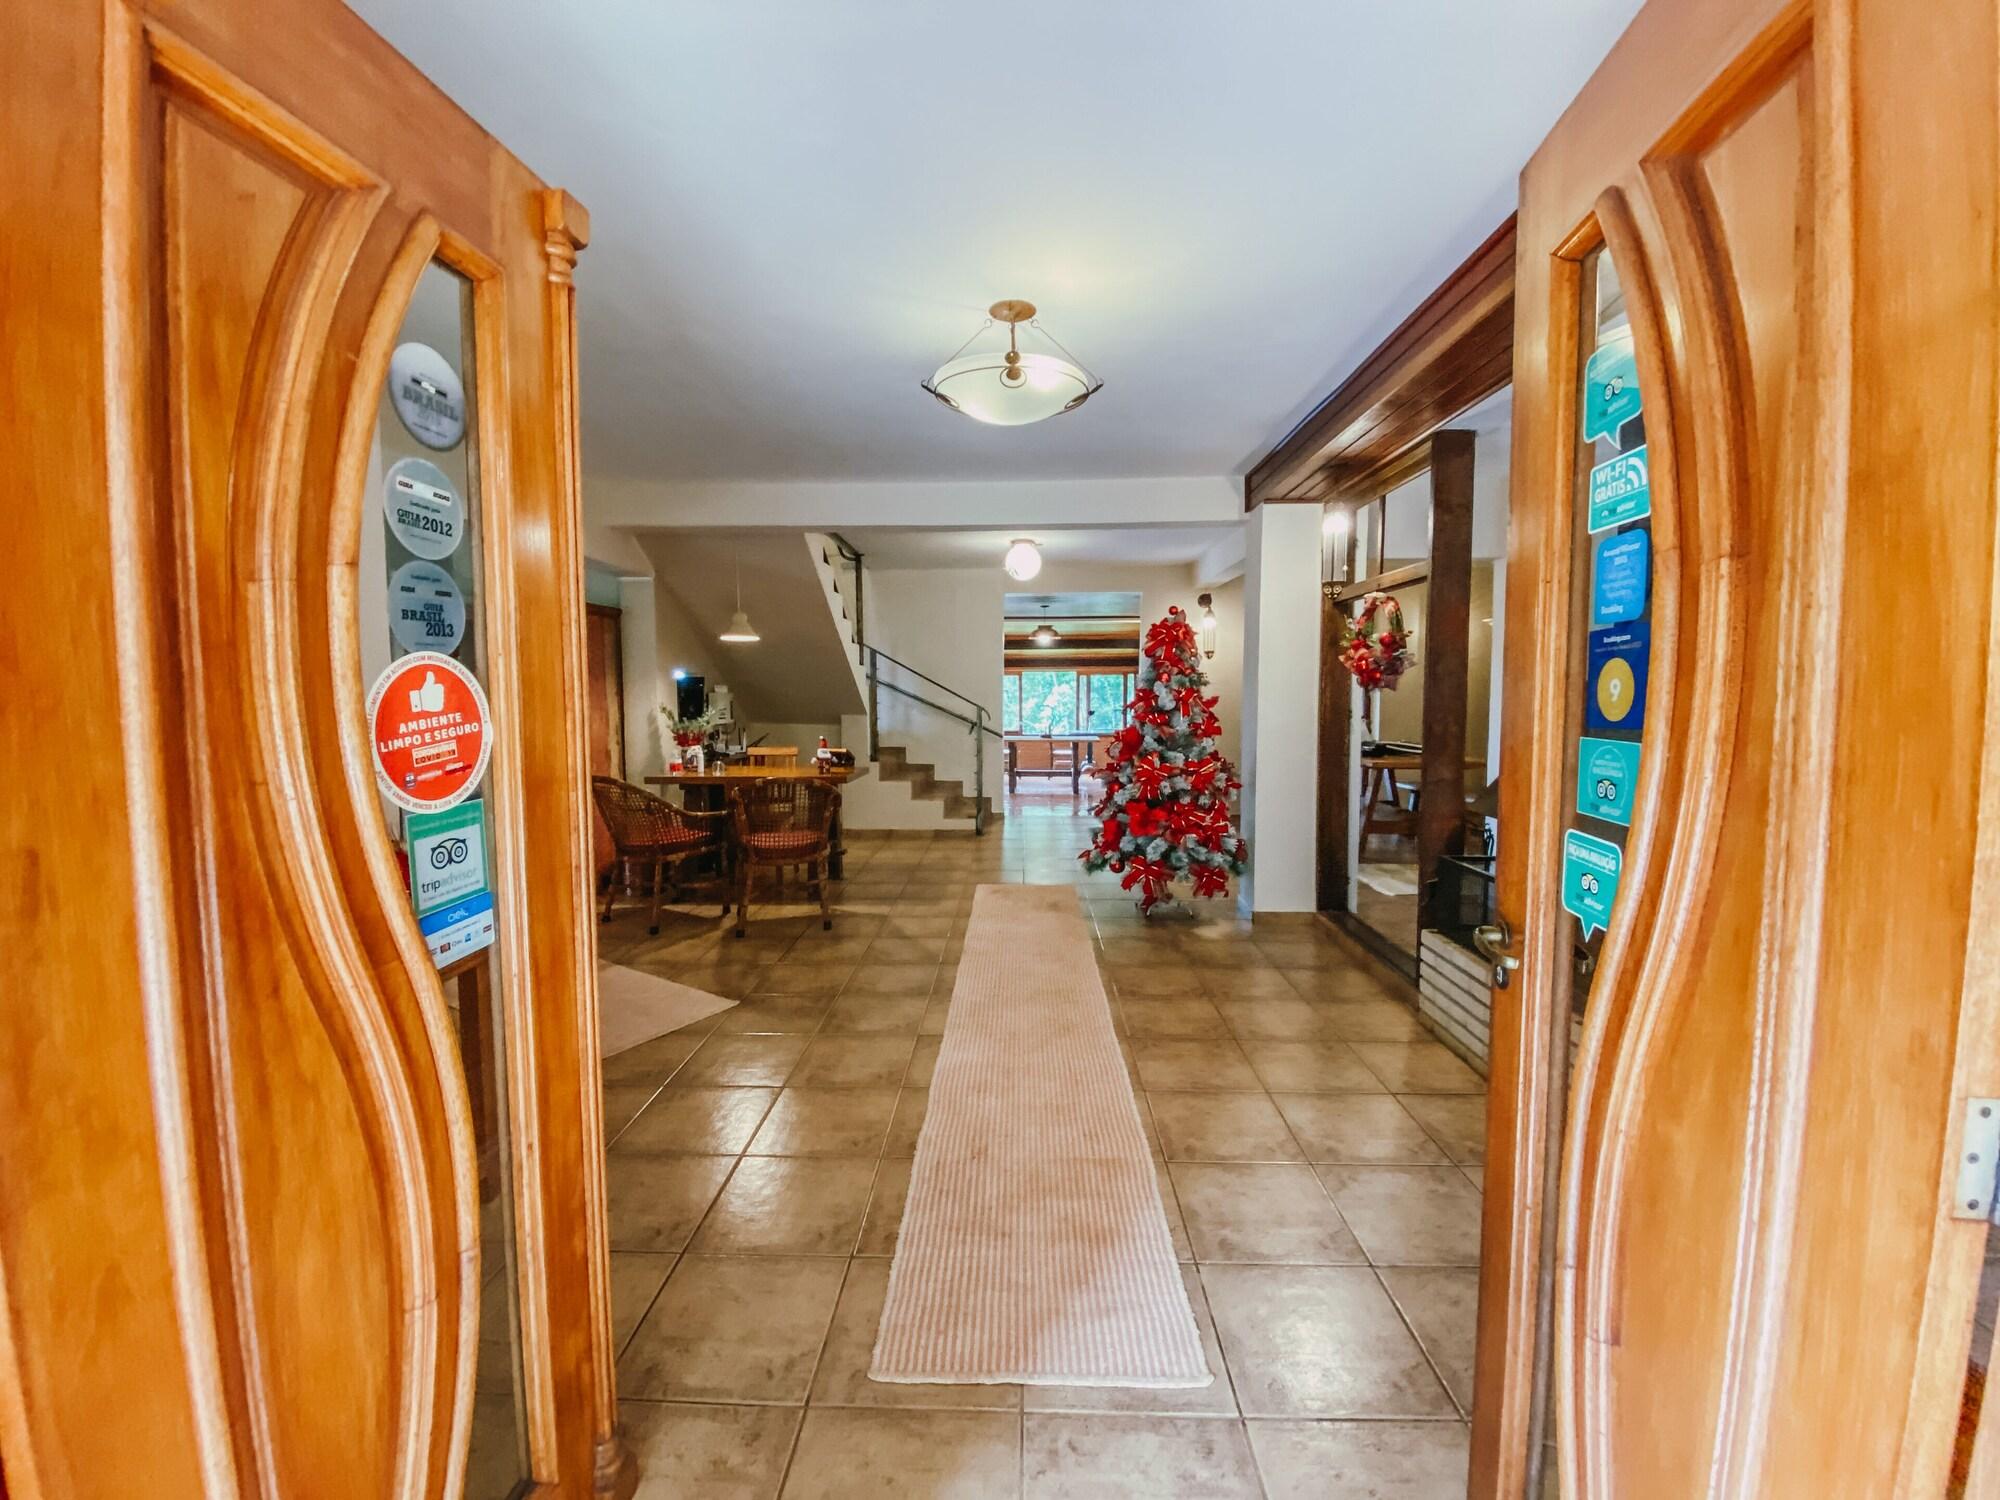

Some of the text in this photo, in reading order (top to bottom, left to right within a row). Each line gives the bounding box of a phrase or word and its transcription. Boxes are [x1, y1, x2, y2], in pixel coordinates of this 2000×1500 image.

[1596, 459, 1626, 485] WI-FI
[397, 508, 453, 538] GUIA 2012
[401, 609, 445, 623] BRASIL
[424, 603, 444, 612] GUIA
[426, 622, 455, 637] 2013
[1610, 679, 1621, 702] 9
[399, 712, 463, 735] AMBIENTE
[380, 734, 421, 753] LIMPO
[424, 732, 432, 743] E
[434, 722, 480, 741] SEGURO
[421, 867, 478, 894] tripadvisor
